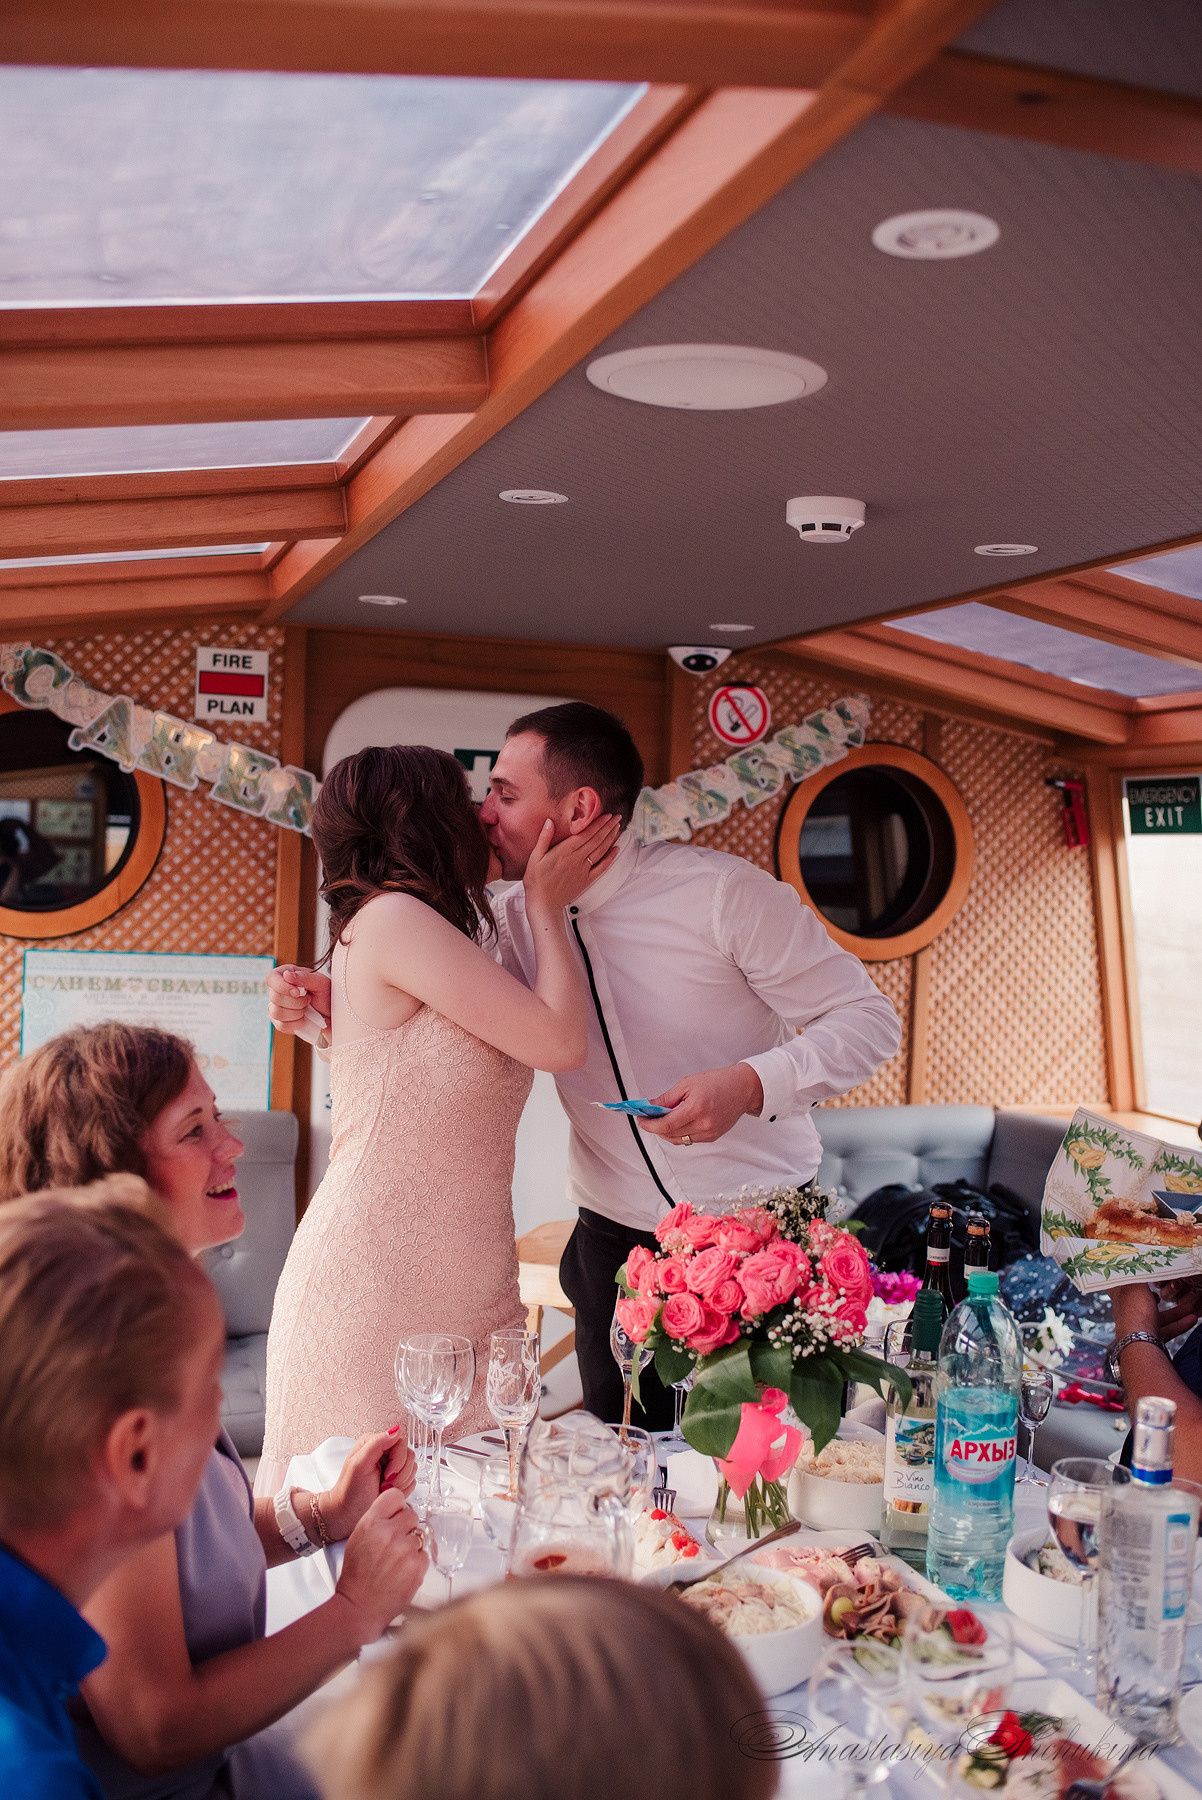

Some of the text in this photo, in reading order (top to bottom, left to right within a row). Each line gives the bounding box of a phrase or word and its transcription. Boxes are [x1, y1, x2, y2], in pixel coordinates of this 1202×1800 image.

[213, 653, 253, 669] FIRE
[208, 699, 254, 715] PLAN
[1129, 785, 1198, 805] EMERGENCY
[1145, 806, 1184, 828] EXIT
[33, 975, 46, 990] С
[51, 975, 121, 992] ДНЕМ
[950, 1438, 1014, 1462] АРХЫЗ
[890, 1470, 930, 1491] Bianco
[905, 1470, 924, 1482] Vino
